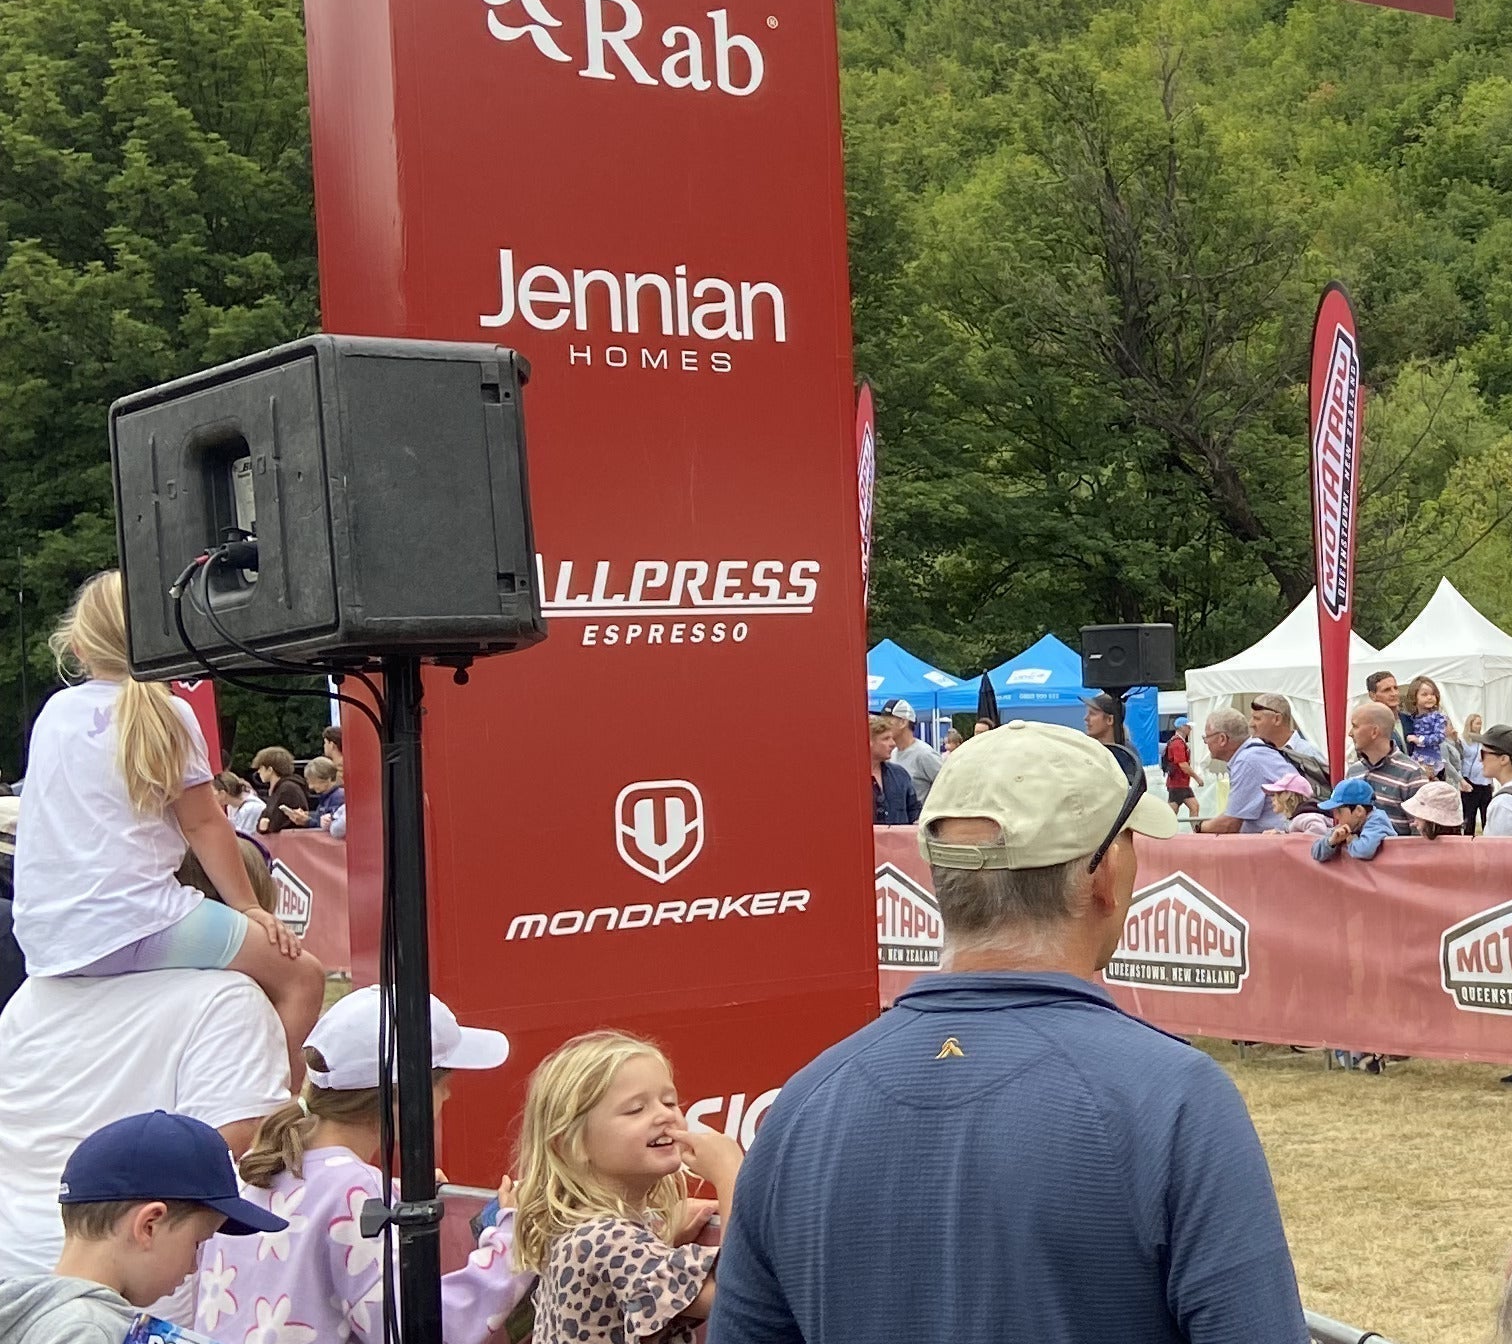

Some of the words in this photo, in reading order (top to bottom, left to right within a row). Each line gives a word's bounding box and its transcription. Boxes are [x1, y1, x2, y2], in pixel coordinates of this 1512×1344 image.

[479, 248, 786, 343] Jennian
[570, 344, 733, 374] HOMES
[1321, 350, 1347, 593] MOTATAPU
[536, 553, 820, 607] LLPRESS
[582, 622, 748, 646] ESPRESSO
[505, 889, 811, 941] MONDRAKER
[876, 886, 939, 939] ATAPU
[1172, 967, 1192, 982] NEW
[1195, 968, 1236, 984] ZEALAND
